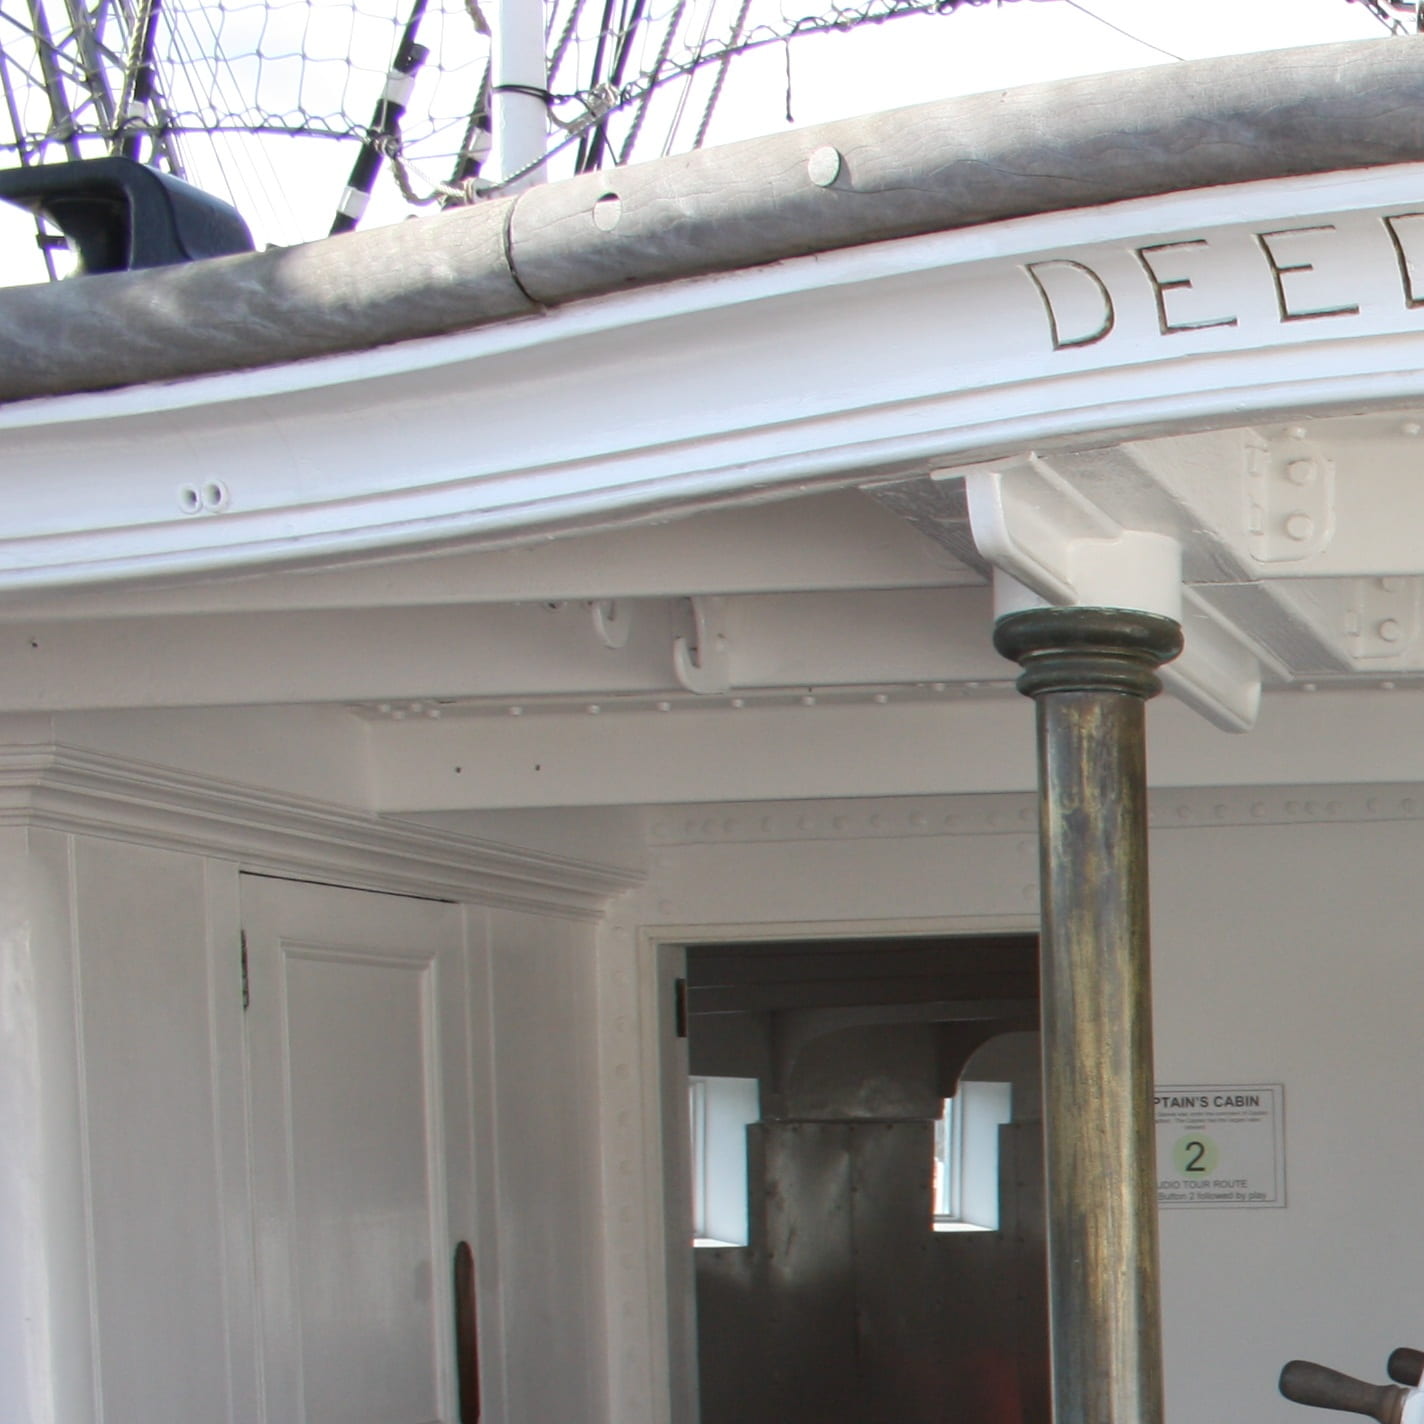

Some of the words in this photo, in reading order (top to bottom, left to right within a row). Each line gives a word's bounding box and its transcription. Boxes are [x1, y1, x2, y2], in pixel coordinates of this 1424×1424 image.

[1153, 1096, 1209, 1108] PTAIN'S
[1213, 1095, 1260, 1108] CABIN
[1185, 1141, 1206, 1172] 2
[1157, 1180, 1181, 1189] UDIO
[1183, 1180, 1210, 1189] TOUR
[1213, 1179, 1248, 1189] ROUTE
